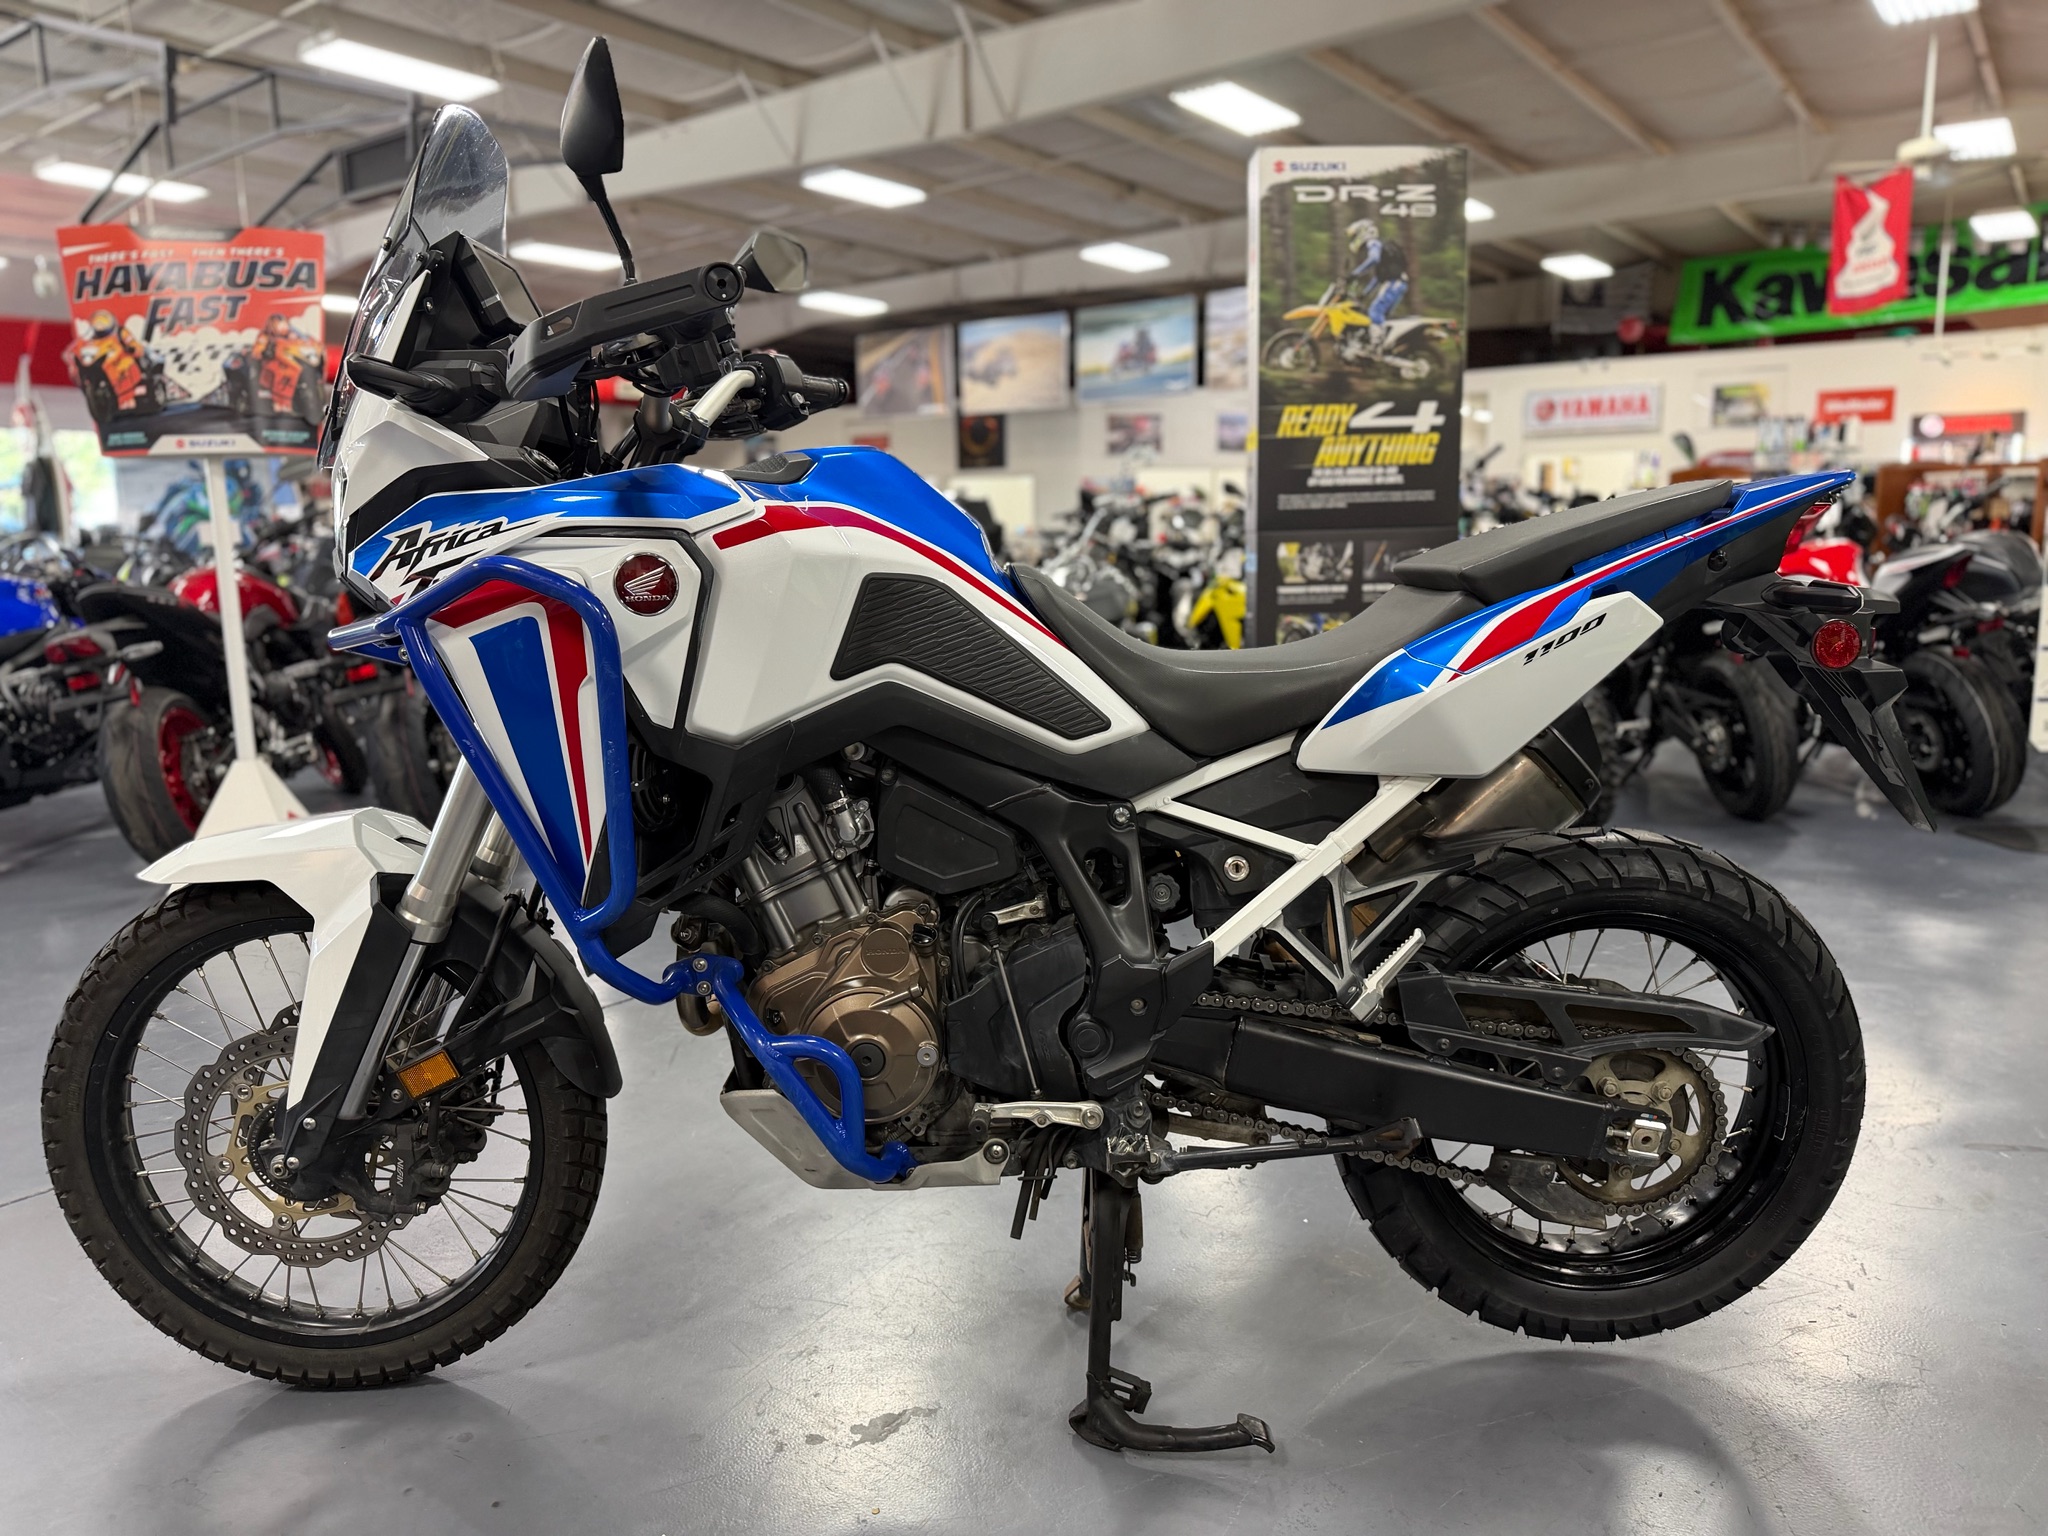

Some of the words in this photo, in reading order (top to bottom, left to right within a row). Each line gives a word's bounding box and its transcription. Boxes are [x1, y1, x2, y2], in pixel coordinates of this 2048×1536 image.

[1290, 161, 1346, 172] SUZUKI
[1293, 184, 1437, 203] DR-Z
[88, 250, 138, 265] THERE'S
[229, 247, 285, 258] THERE'S
[73, 257, 319, 303] HAYABUSA
[143, 293, 248, 342] FAST
[1562, 393, 1650, 419] YAMAHA
[1276, 403, 1358, 439] READY
[1349, 400, 1446, 435] 4
[188, 438, 236, 448] SUZUKI
[1313, 431, 1441, 468] ANYTHING
[369, 519, 543, 581] Africa
[625, 594, 671, 603] HONDA
[1523, 612, 1607, 666] 1100
[866, 948, 906, 956] HONDA
